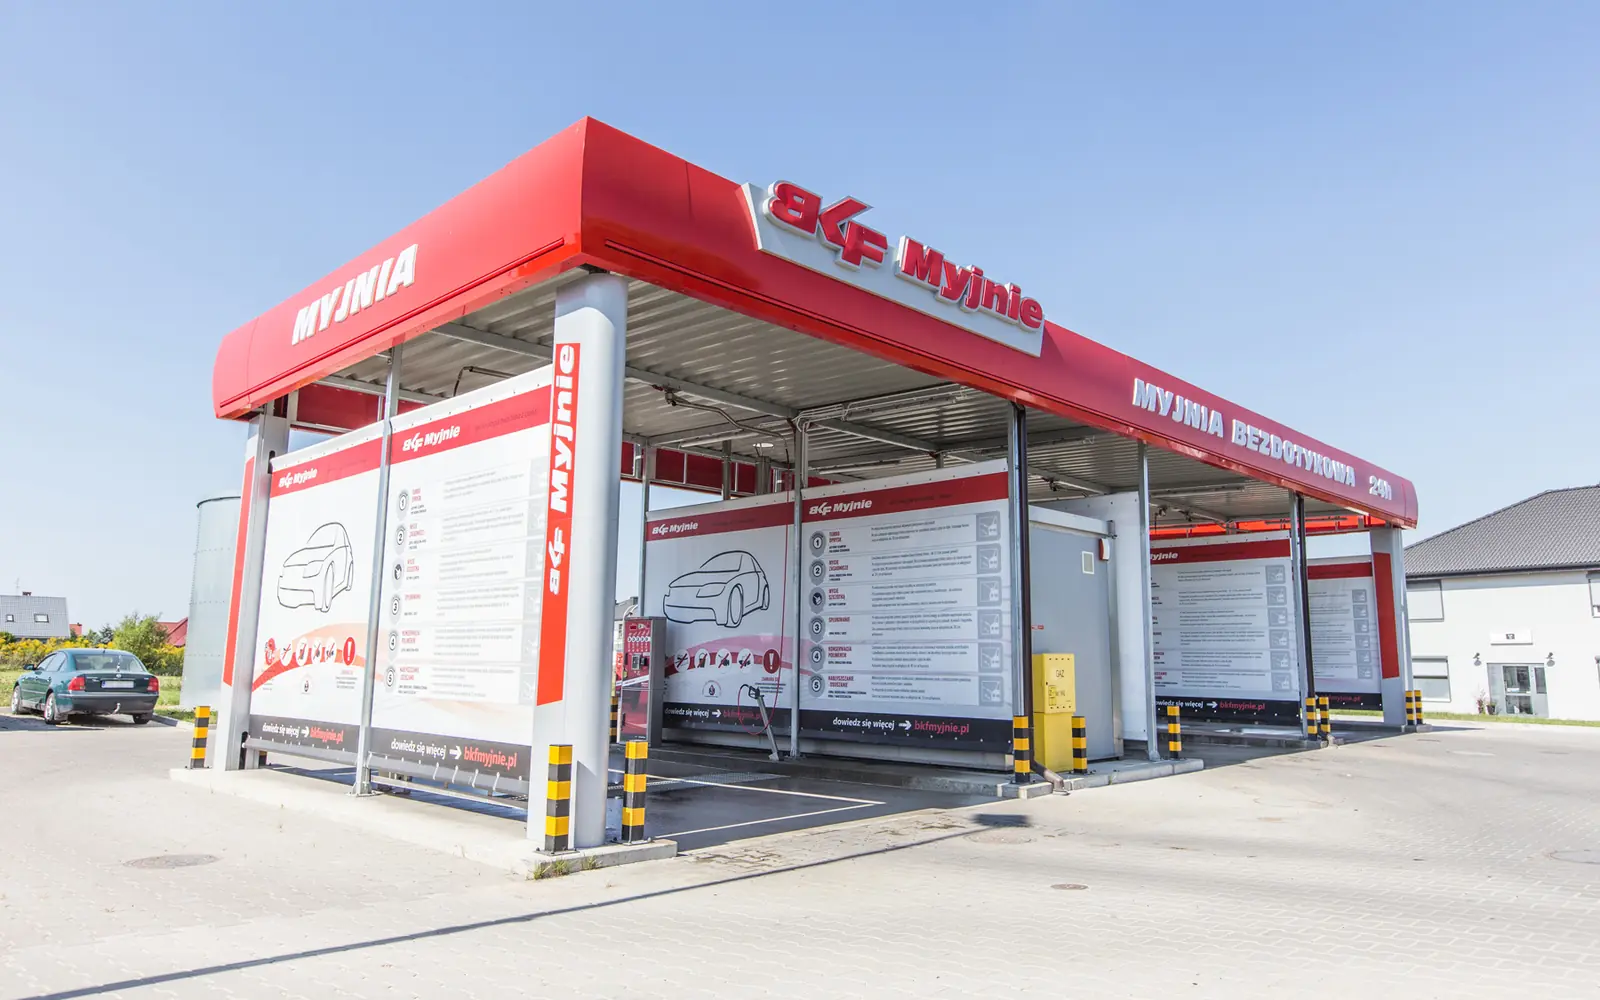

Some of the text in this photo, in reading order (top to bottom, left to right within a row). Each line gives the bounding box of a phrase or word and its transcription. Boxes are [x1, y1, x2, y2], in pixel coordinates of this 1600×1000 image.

[762, 180, 1043, 332] BKF Myjnie
[291, 244, 418, 345] MYJNIA
[424, 425, 460, 445] Myjnie
[551, 345, 575, 513] Myjnie
[1132, 378, 1392, 500] MYJNIA BEZDOTYKOWA 24h
[293, 468, 317, 484] Myjnie
[833, 499, 872, 513] Myjnie
[669, 522, 698, 533] Myjnie
[1150, 552, 1178, 561] yjnie
[693, 709, 710, 718] więcej
[1185, 701, 1204, 709] więcej
[1220, 703, 1265, 711] bkfmyjnie.pl
[833, 717, 970, 735] dowiedz się więcej bkfmyjnie.pl
[391, 738, 518, 770] dowiedz się więcej bkfmyjnie.pl
